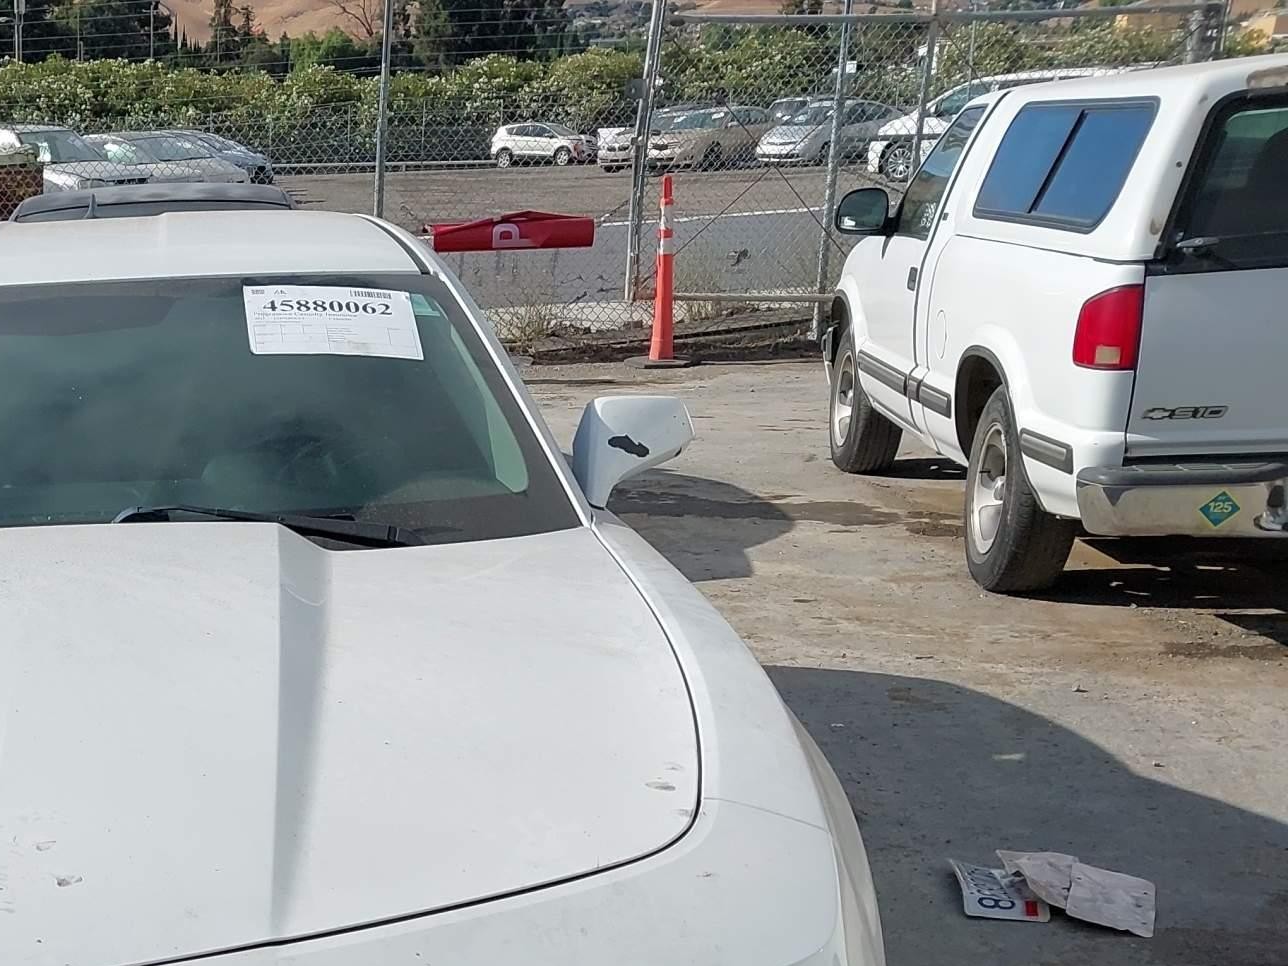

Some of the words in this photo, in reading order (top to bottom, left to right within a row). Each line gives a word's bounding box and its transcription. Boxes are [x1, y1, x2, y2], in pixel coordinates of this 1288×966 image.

[263, 299, 393, 316] 45880062
[1171, 406, 1228, 420] S10
[1208, 501, 1233, 513] 125
